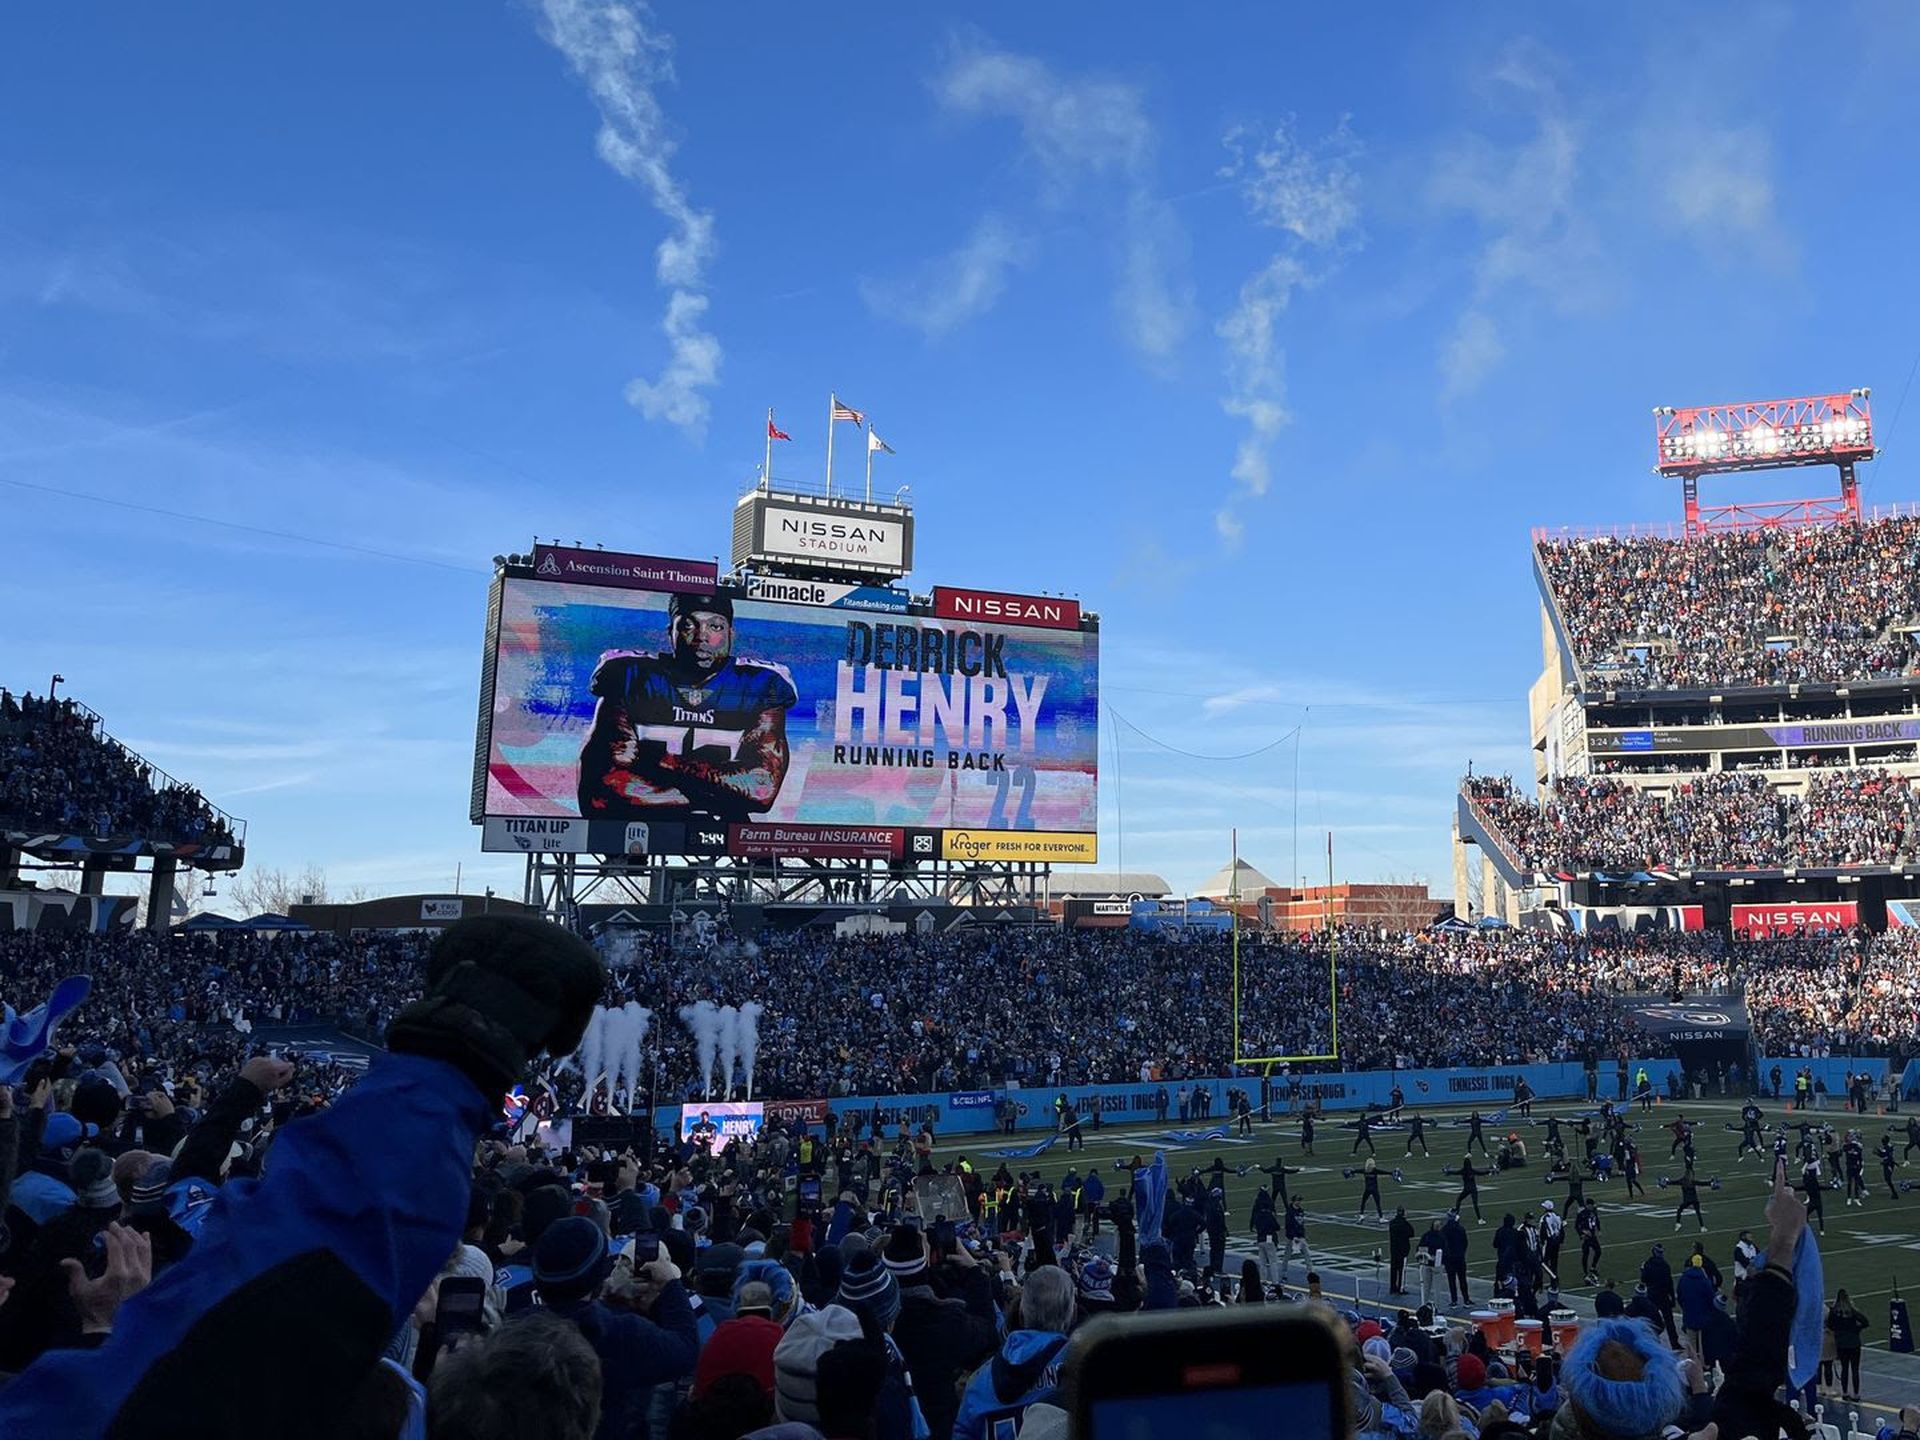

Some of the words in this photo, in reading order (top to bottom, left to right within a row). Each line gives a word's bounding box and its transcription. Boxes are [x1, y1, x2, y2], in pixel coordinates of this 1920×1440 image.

[782, 518, 886, 543] NISSAN
[799, 536, 868, 555] STADIUM
[565, 560, 631, 577] Ascension
[632, 567, 665, 580] Saint
[666, 569, 716, 586] Thomas
[748, 578, 826, 603] Pinnacle
[843, 597, 907, 611] TitansBanking.com
[954, 596, 1061, 621] NISSAN
[846, 620, 1008, 679] DERRICK
[834, 659, 1050, 753] HENRY
[1802, 725, 1864, 743] RUNNING
[1865, 722, 1902, 739] BACK
[833, 745, 935, 768] RUNNING
[947, 751, 1006, 772] BACK
[985, 767, 1037, 830] 22
[505, 819, 547, 833] TITAN
[550, 821, 570, 834] UP
[627, 827, 647, 840] Lite
[739, 828, 771, 840] Farm
[774, 829, 817, 841] Bureau
[819, 830, 893, 844] INSURANCE
[543, 837, 561, 850] Lite
[698, 831, 724, 845] 7:44
[950, 832, 992, 858] Kroger
[996, 842, 1022, 851] FRESH
[1024, 843, 1041, 851] FOR
[1749, 912, 1841, 925] NISSAN
[1670, 1031, 1723, 1040] NISSAN
